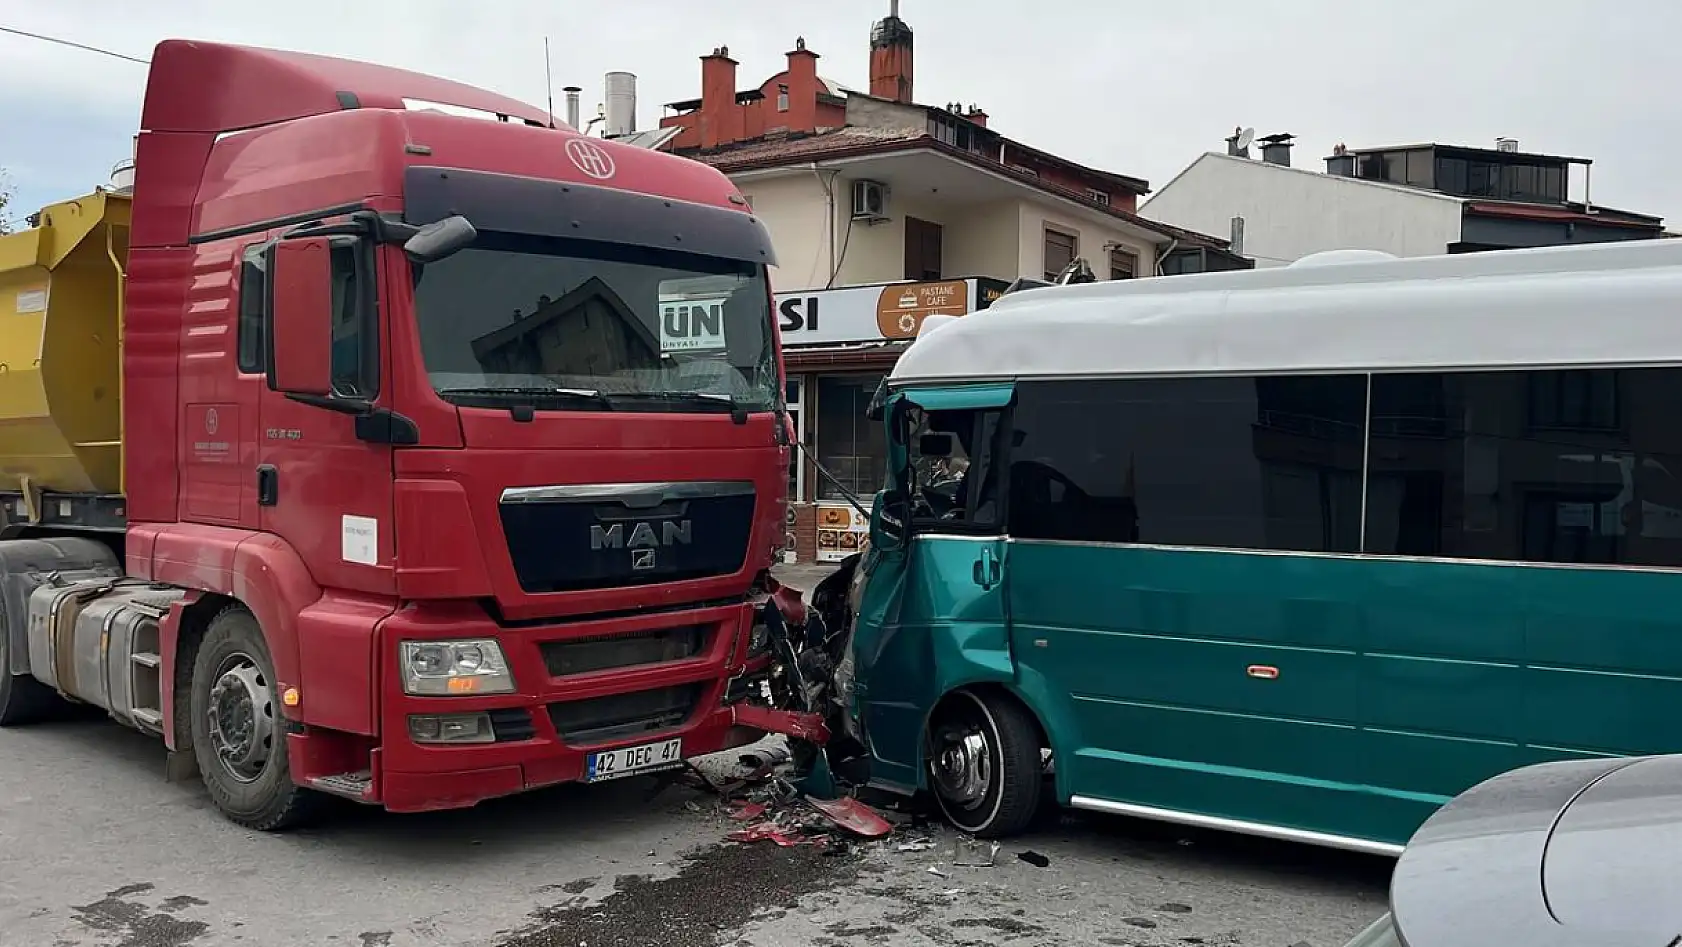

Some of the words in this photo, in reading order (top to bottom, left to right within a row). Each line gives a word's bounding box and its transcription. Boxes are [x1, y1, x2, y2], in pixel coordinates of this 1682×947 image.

[920, 285, 955, 295] PASTANE
[926, 297, 947, 306] CAFE
[590, 520, 692, 549] MAN
[596, 753, 616, 773] 42
[625, 746, 653, 768] DEC
[662, 740, 679, 760] 47
